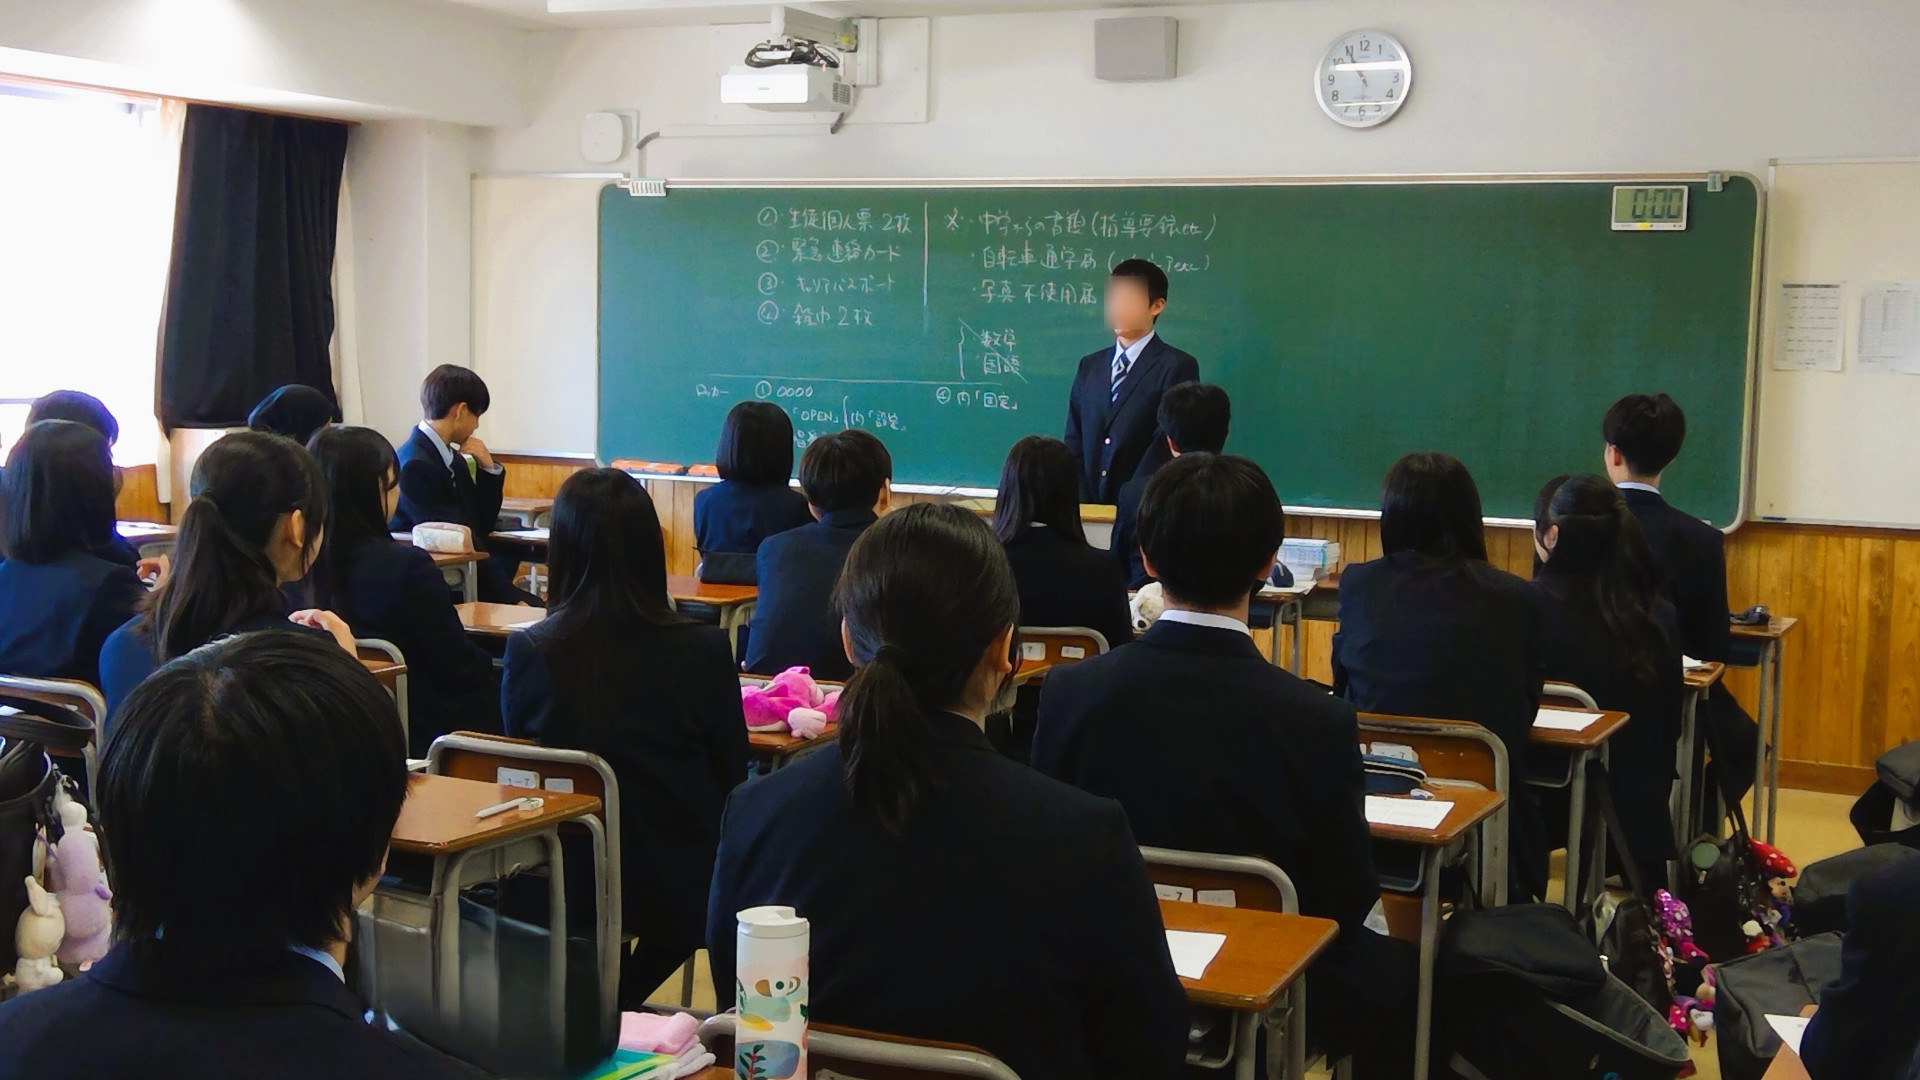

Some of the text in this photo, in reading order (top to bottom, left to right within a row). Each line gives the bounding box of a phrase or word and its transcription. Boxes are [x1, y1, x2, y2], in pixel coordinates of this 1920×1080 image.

[1359, 39, 1371, 52] 12
[1378, 43, 1382, 55] 1
[1327, 73, 1335, 86] 9
[1392, 71, 1400, 84] 3
[1331, 89, 1339, 102] 8
[1385, 88, 1394, 99] 4
[1358, 103, 1366, 118] 6
